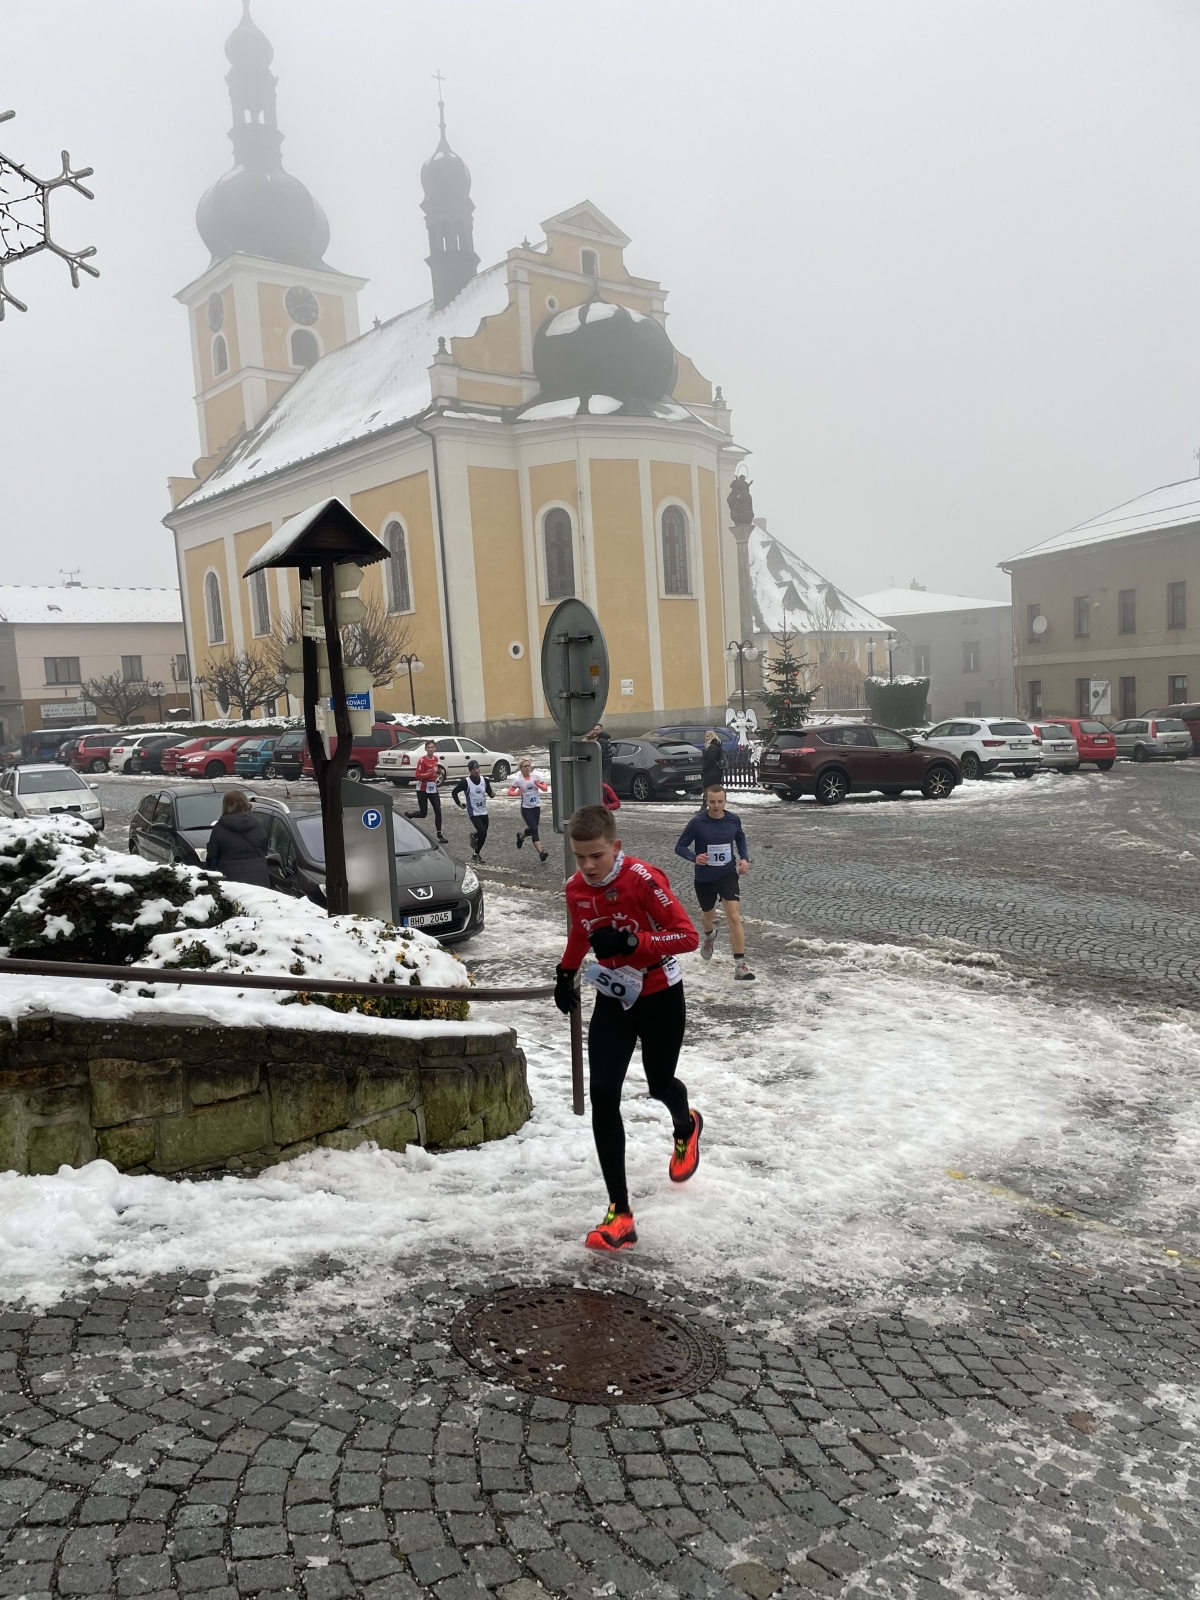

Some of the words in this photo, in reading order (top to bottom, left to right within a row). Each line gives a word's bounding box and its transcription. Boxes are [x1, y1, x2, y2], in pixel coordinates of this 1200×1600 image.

[367, 812, 378, 826] P
[713, 853, 725, 862] 16
[430, 912, 449, 923] 2045
[595, 971, 626, 997] 50
